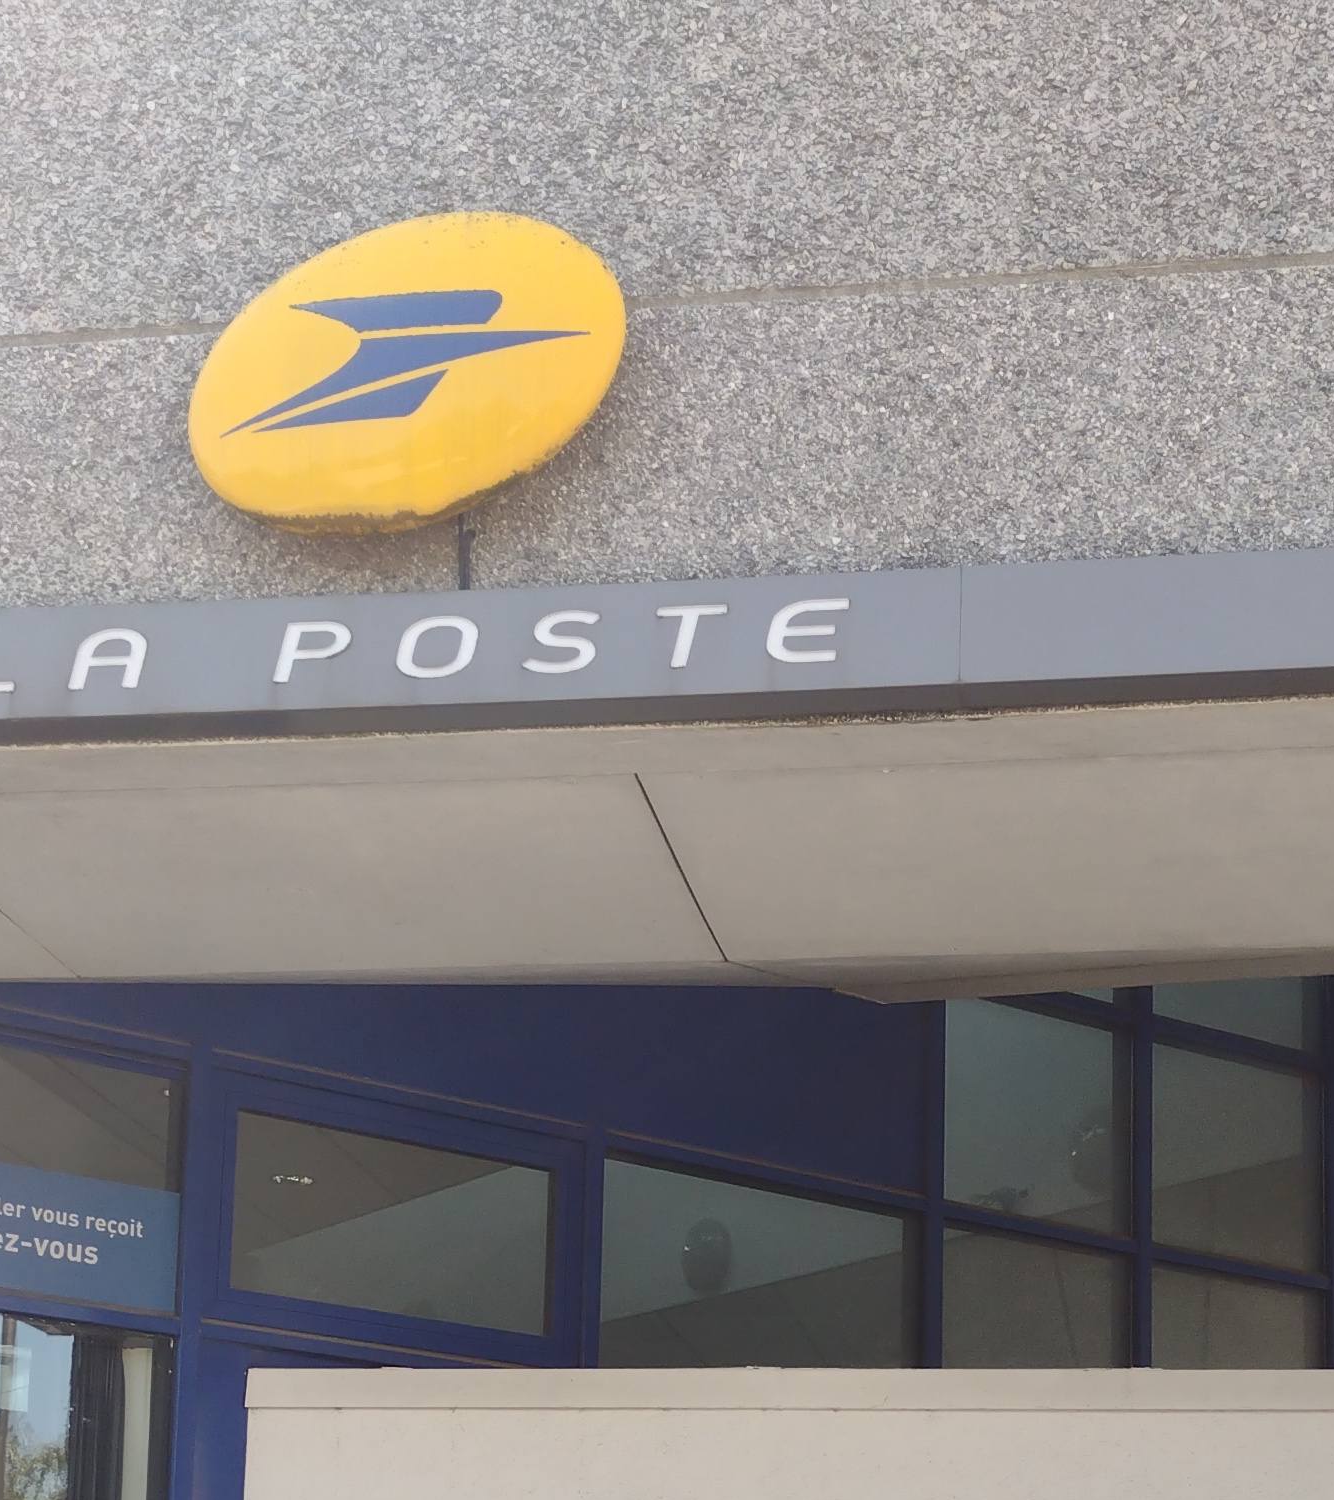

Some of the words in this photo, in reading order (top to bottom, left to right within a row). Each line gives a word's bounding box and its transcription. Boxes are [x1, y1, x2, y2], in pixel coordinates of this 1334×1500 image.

[271, 597, 850, 685] POSTE
[31, 1205, 80, 1228] vous
[85, 1215, 144, 1238] reçoit
